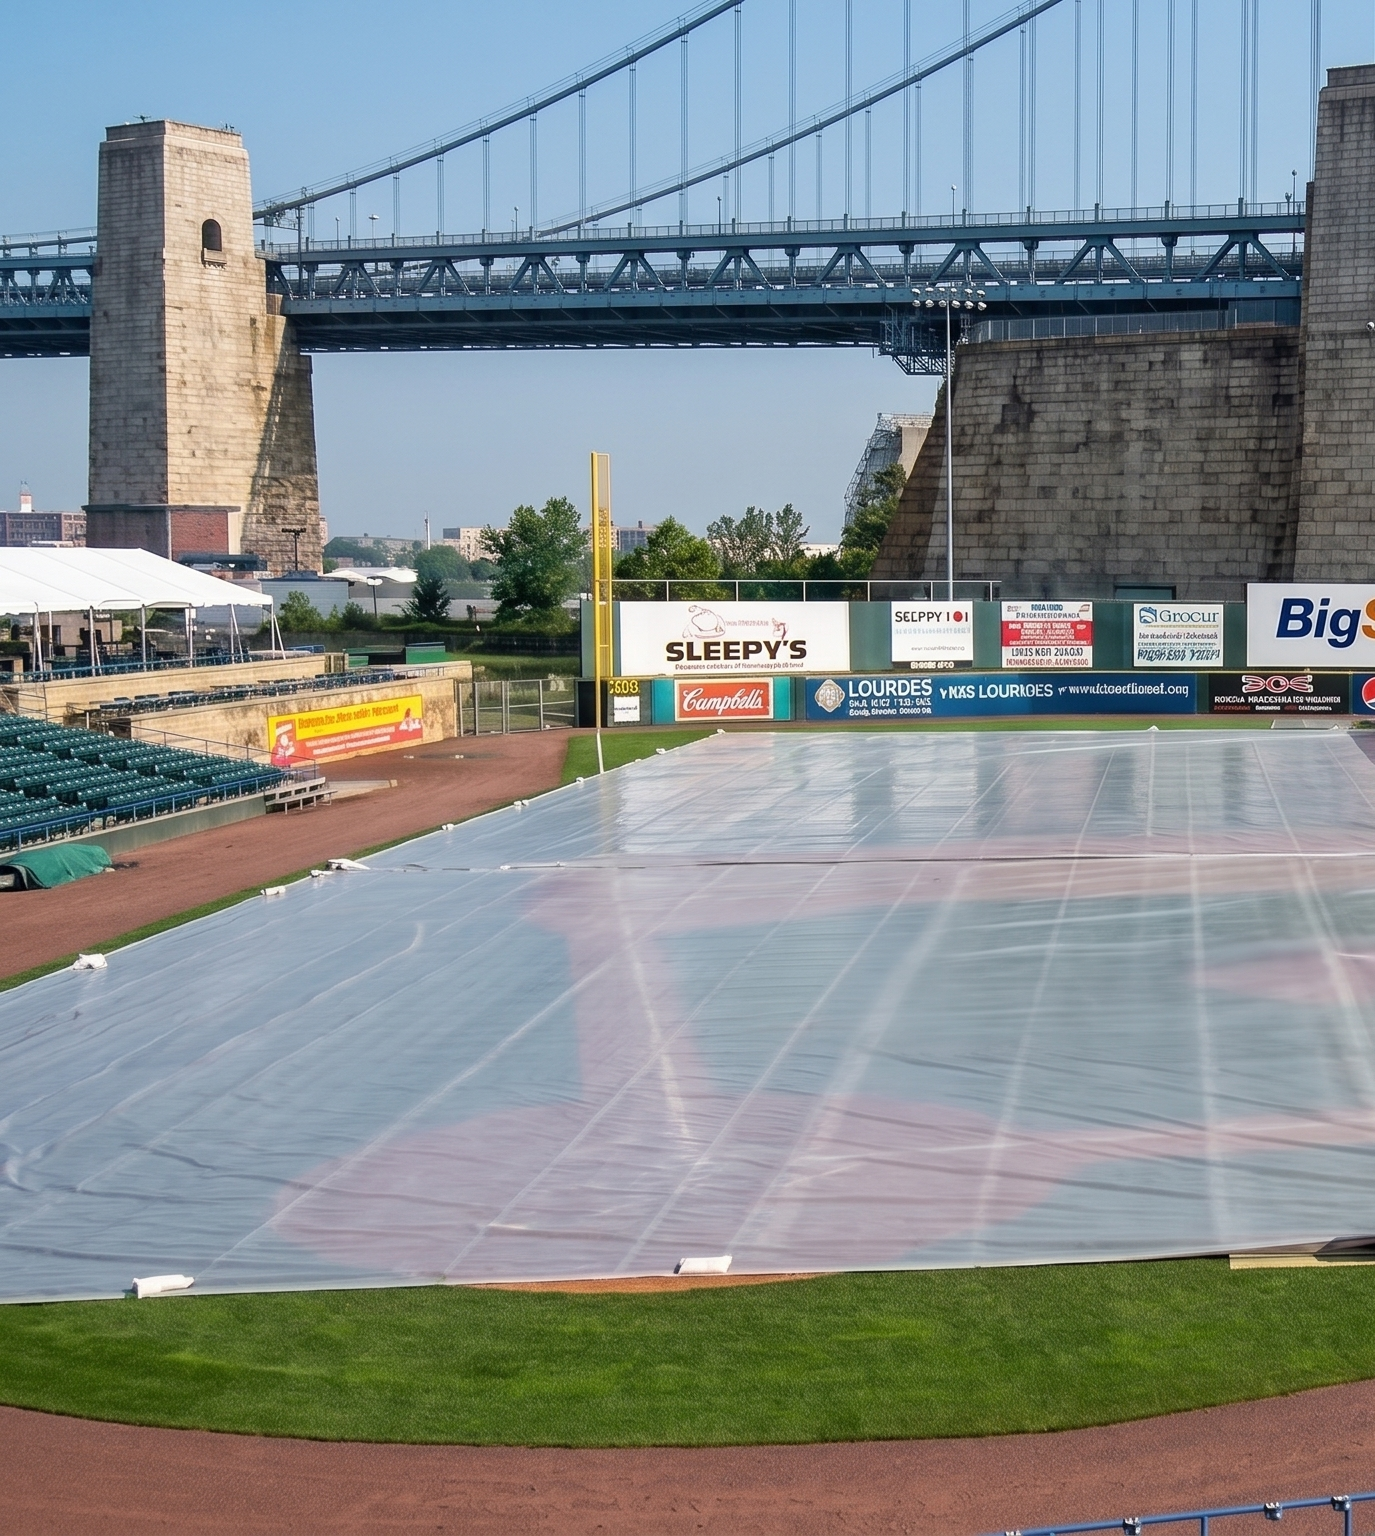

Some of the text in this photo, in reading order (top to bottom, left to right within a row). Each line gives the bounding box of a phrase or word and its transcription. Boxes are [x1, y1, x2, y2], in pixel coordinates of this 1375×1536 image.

[665, 639, 807, 662] SLEEPY'S
[848, 678, 933, 698] LOURDES
[682, 687, 764, 715] Campbell's
